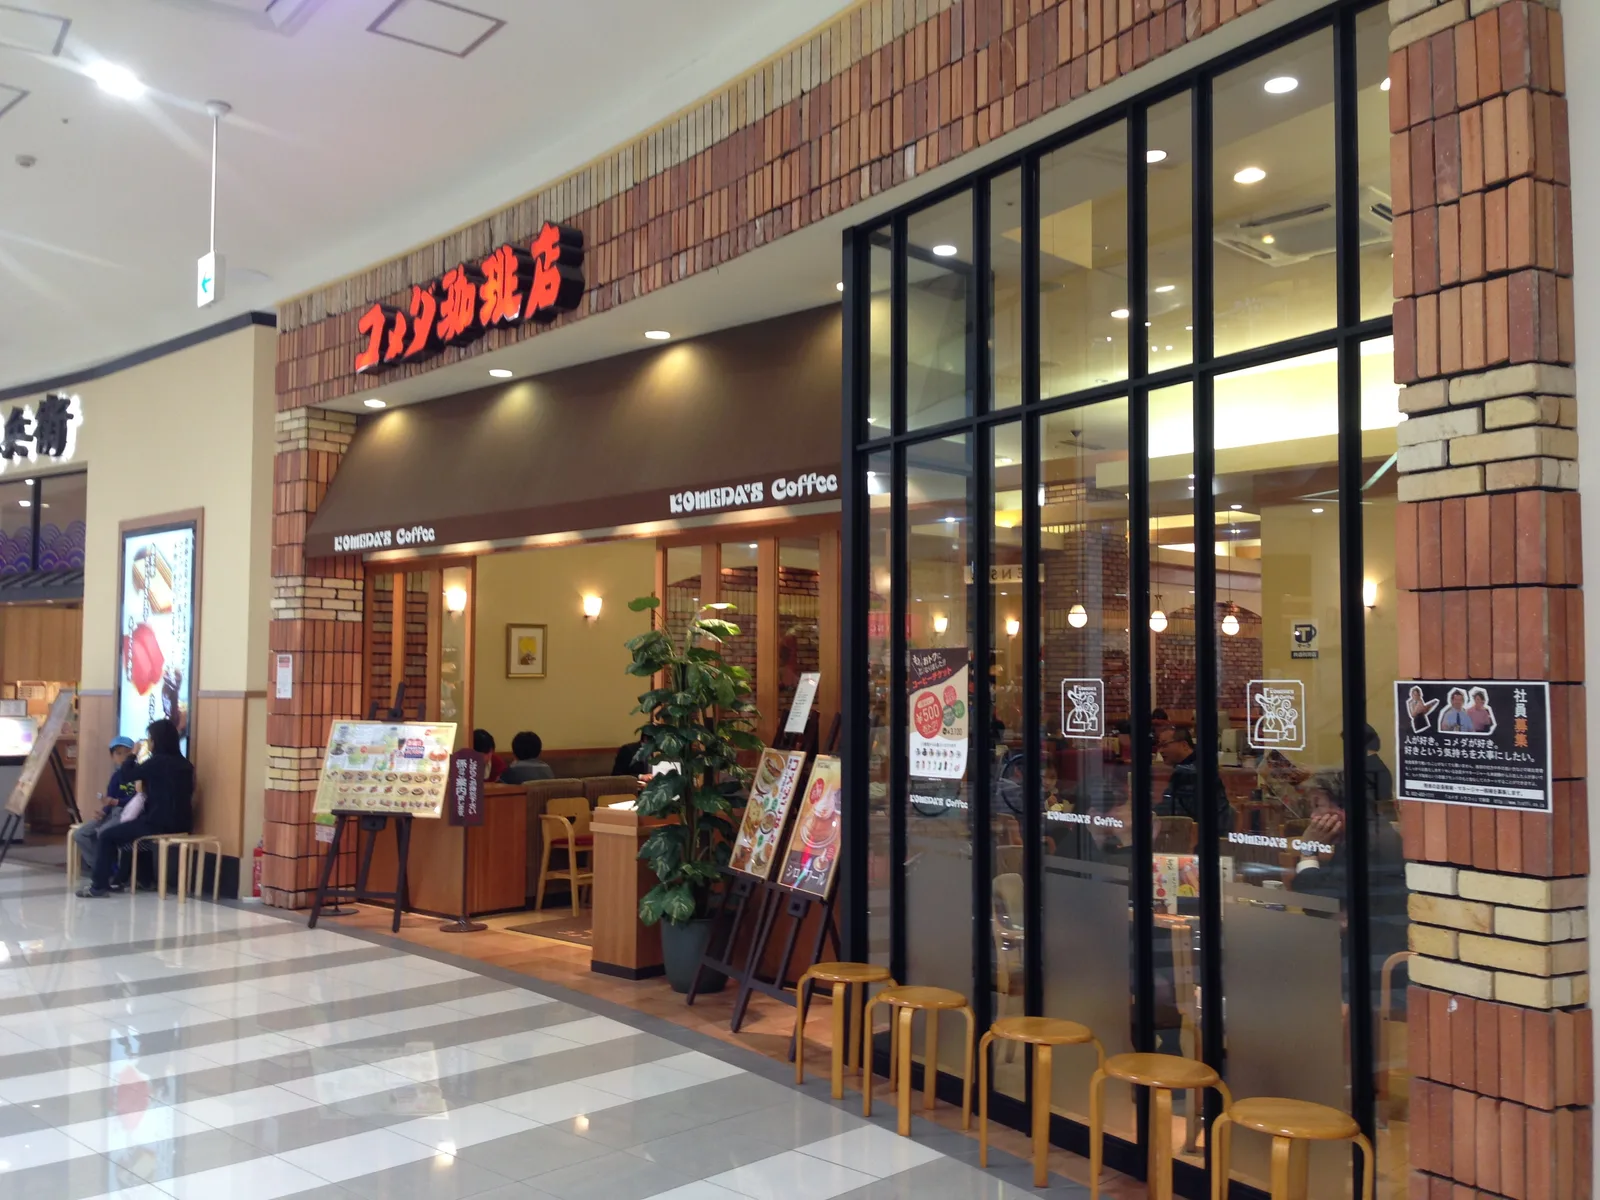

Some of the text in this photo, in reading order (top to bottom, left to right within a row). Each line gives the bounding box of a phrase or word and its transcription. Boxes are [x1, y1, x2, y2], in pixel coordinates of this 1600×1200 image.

[356, 221, 563, 374] コメダ珈琲店
[669, 472, 838, 514] KOMEDA'S Coffee
[334, 525, 436, 552] KOMEDA'S Coffee
[916, 704, 940, 725] ¥500
[1513, 688, 1528, 748] 社員募集
[1404, 746, 1535, 763] 好きという気持ちを大事にしたい。
[1047, 810, 1123, 828] KOMEDA'S Coffee
[1228, 832, 1333, 854] KOMEDA'S Coffee
[785, 863, 827, 887] シロワール
